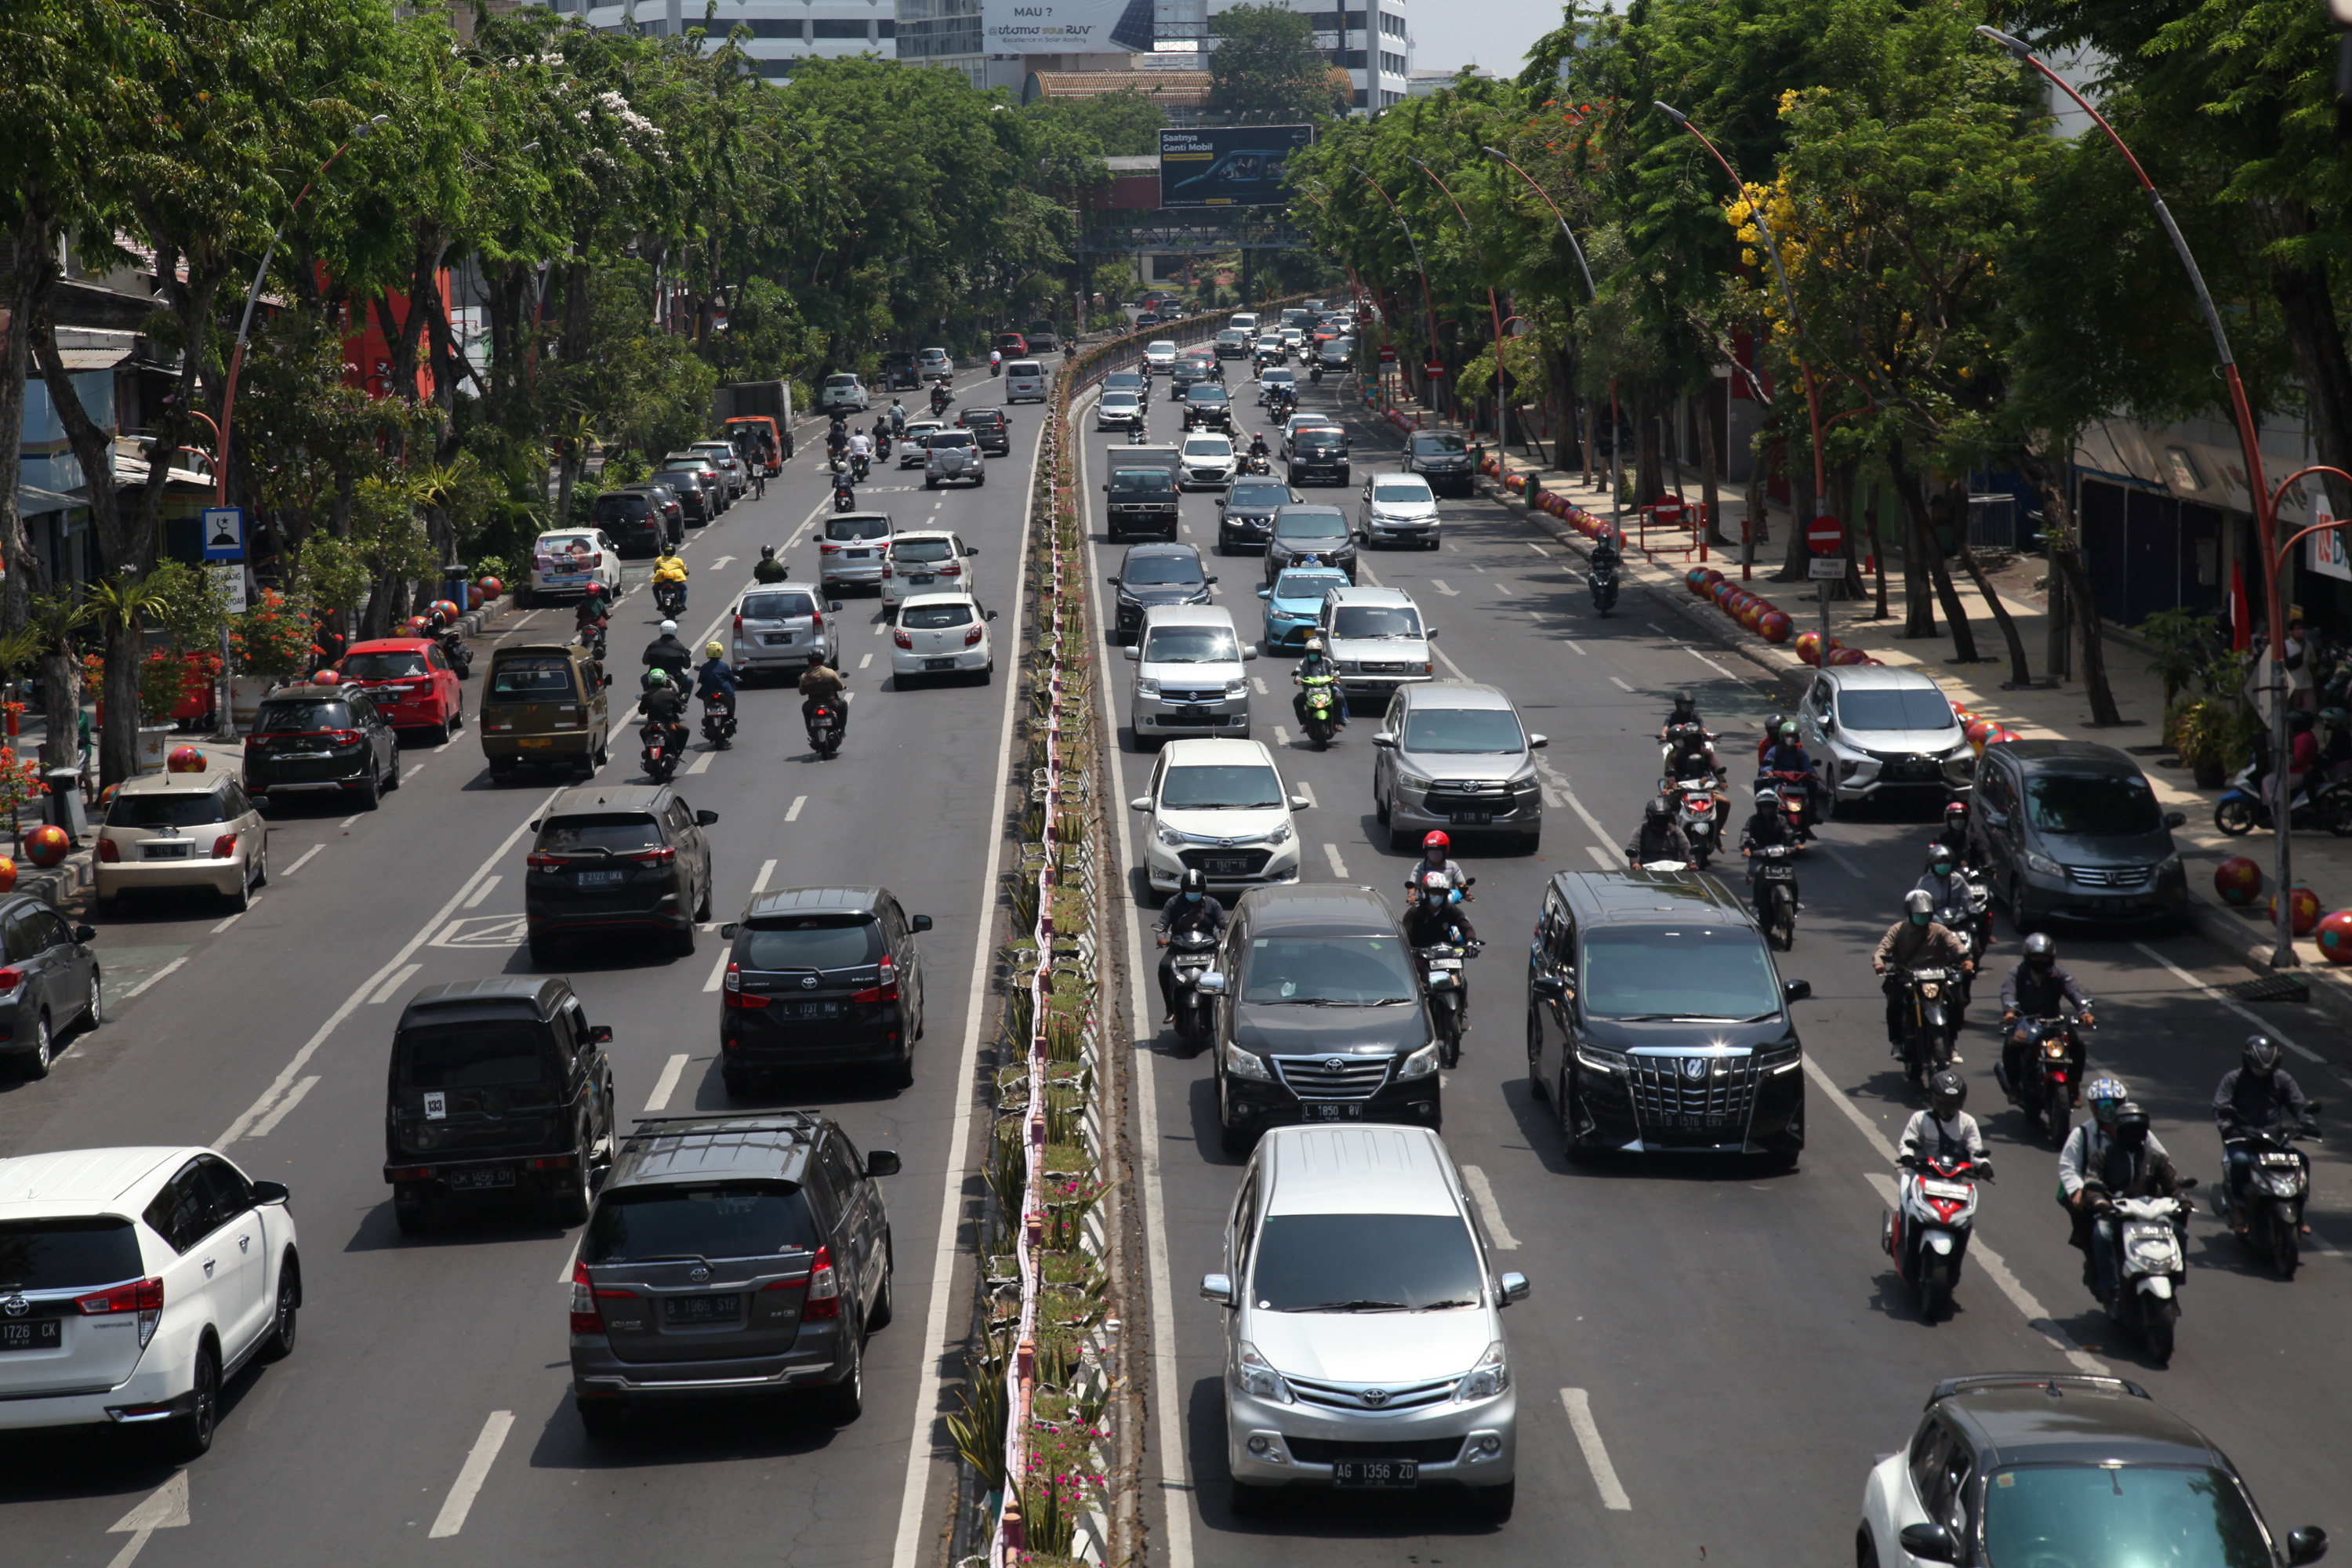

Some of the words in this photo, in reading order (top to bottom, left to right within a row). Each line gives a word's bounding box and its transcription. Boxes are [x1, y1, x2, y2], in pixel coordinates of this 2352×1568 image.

[1014, 7, 1043, 16] MAU
[1046, 7, 1053, 16] ?
[1163, 134, 1198, 143] Saatnya
[1189, 143, 1213, 151] Mobil
[579, 873, 584, 881] B
[609, 871, 623, 880] UKA
[785, 1006, 790, 1014] L
[800, 1004, 817, 1014] 1737
[825, 1003, 837, 1012] MW
[427, 1099, 443, 1112] 133
[1305, 1106, 1310, 1116] L
[1318, 1105, 1338, 1116] 1850
[1665, 1116, 1672, 1127] B
[1679, 1116, 1700, 1127] 1576
[1706, 1116, 1723, 1127] ERV
[455, 1173, 468, 1185] DK
[472, 1171, 495, 1183] 1456
[667, 1301, 675, 1315] B
[717, 1297, 737, 1312] SYP
[3, 1325, 31, 1339] 1726
[42, 1323, 56, 1338] CK
[1337, 1464, 1352, 1478] AG
[1363, 1464, 1391, 1479] 1356
[1398, 1465, 1414, 1479] ZD
